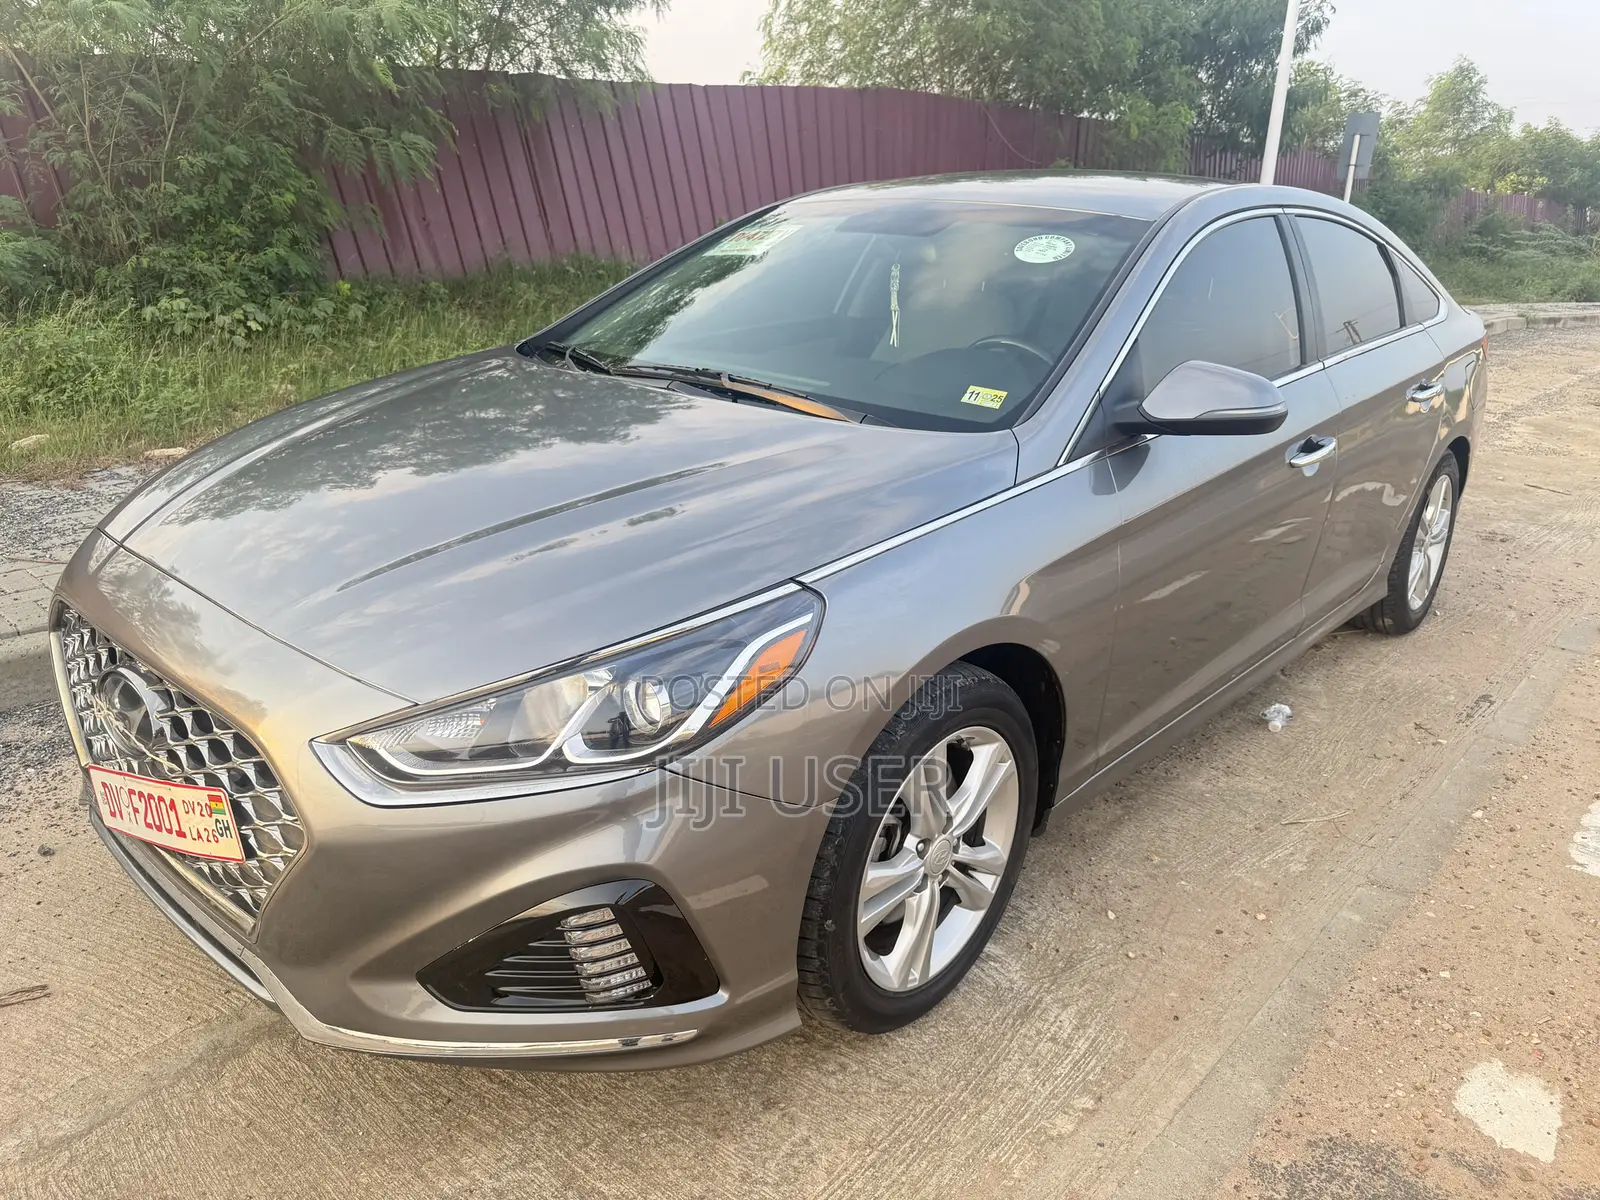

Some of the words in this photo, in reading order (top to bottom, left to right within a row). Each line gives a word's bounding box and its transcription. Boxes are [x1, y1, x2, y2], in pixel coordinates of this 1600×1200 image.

[968, 390, 981, 402] 11
[990, 394, 1004, 403] 25
[101, 781, 124, 821] DV
[127, 788, 187, 839] F2001
[214, 818, 233, 839] GH
